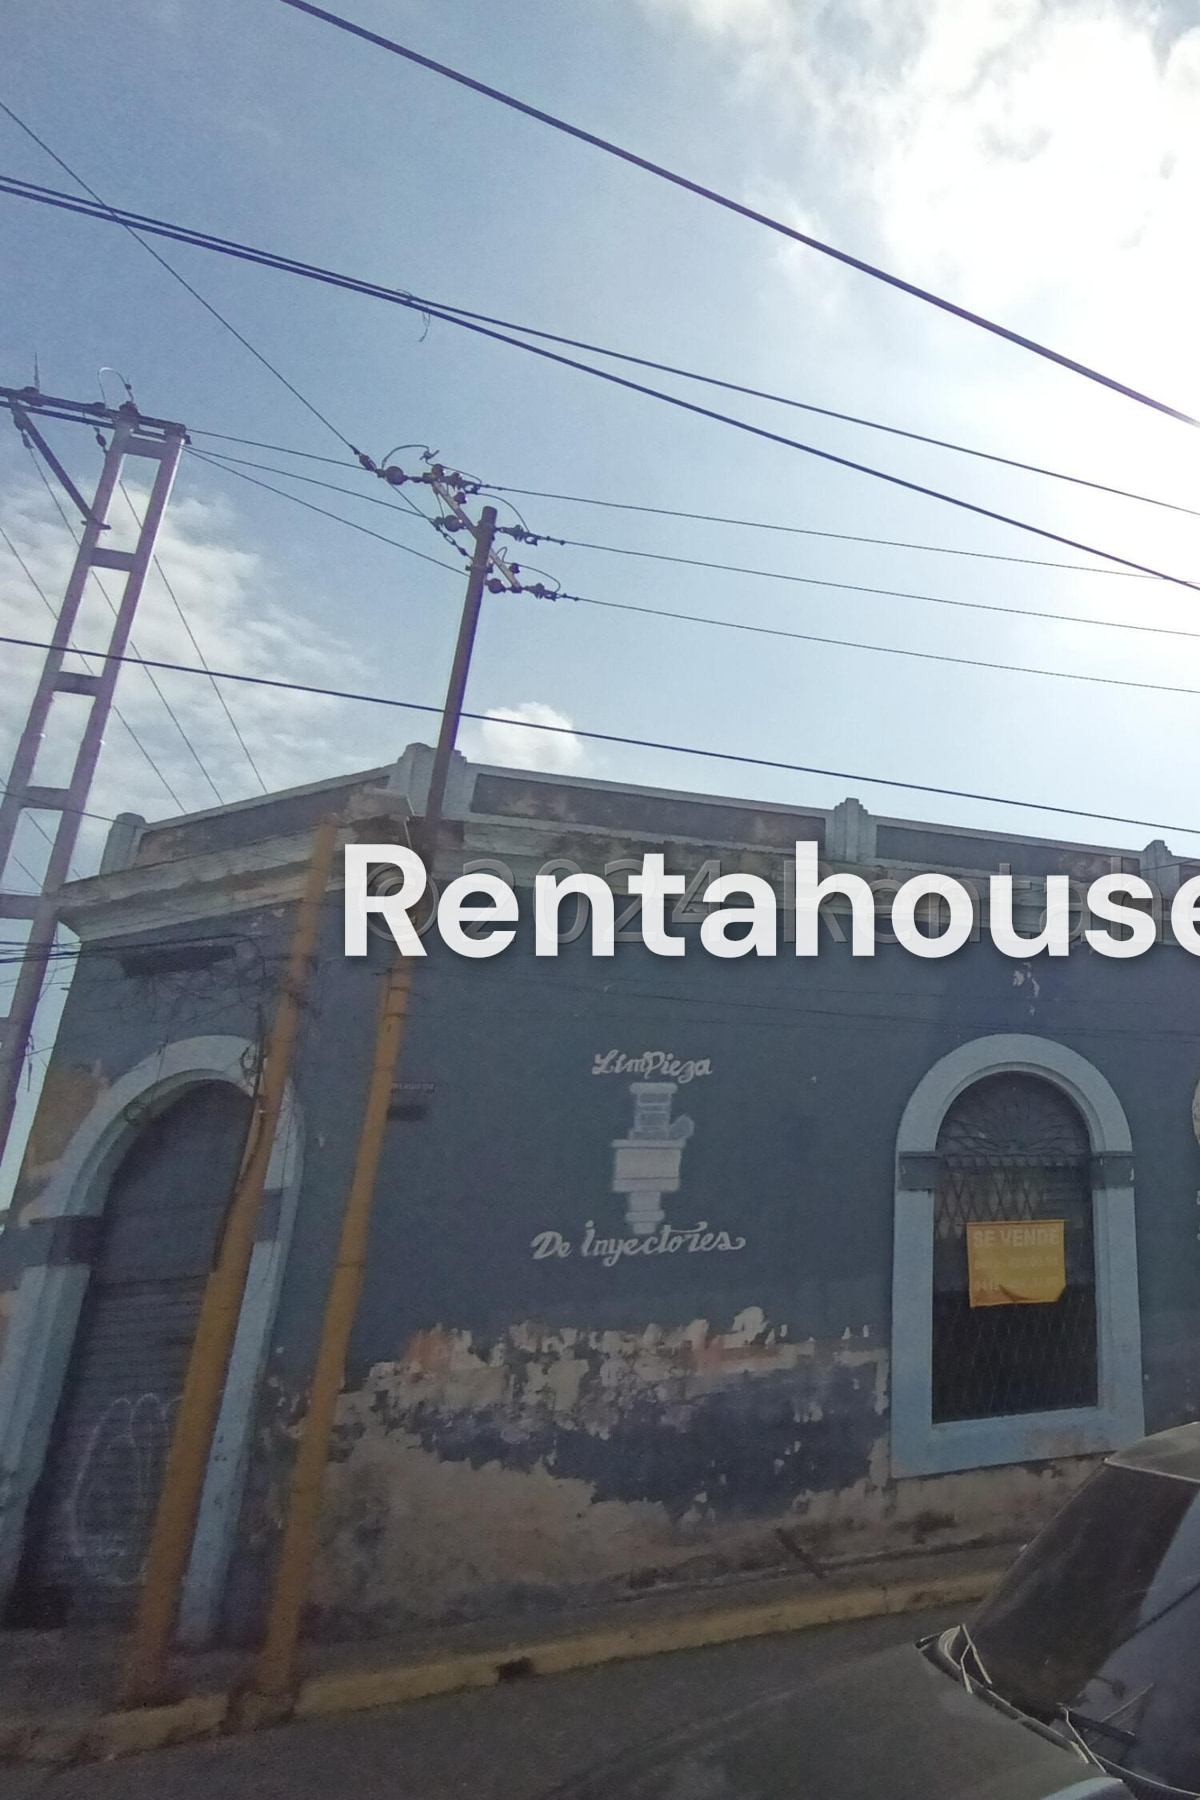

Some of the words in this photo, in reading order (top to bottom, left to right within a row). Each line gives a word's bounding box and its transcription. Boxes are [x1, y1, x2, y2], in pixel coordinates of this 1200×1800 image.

[531, 1230, 572, 1259] De
[973, 1229, 995, 1249] SE
[1000, 1227, 1060, 1248] VENDE
